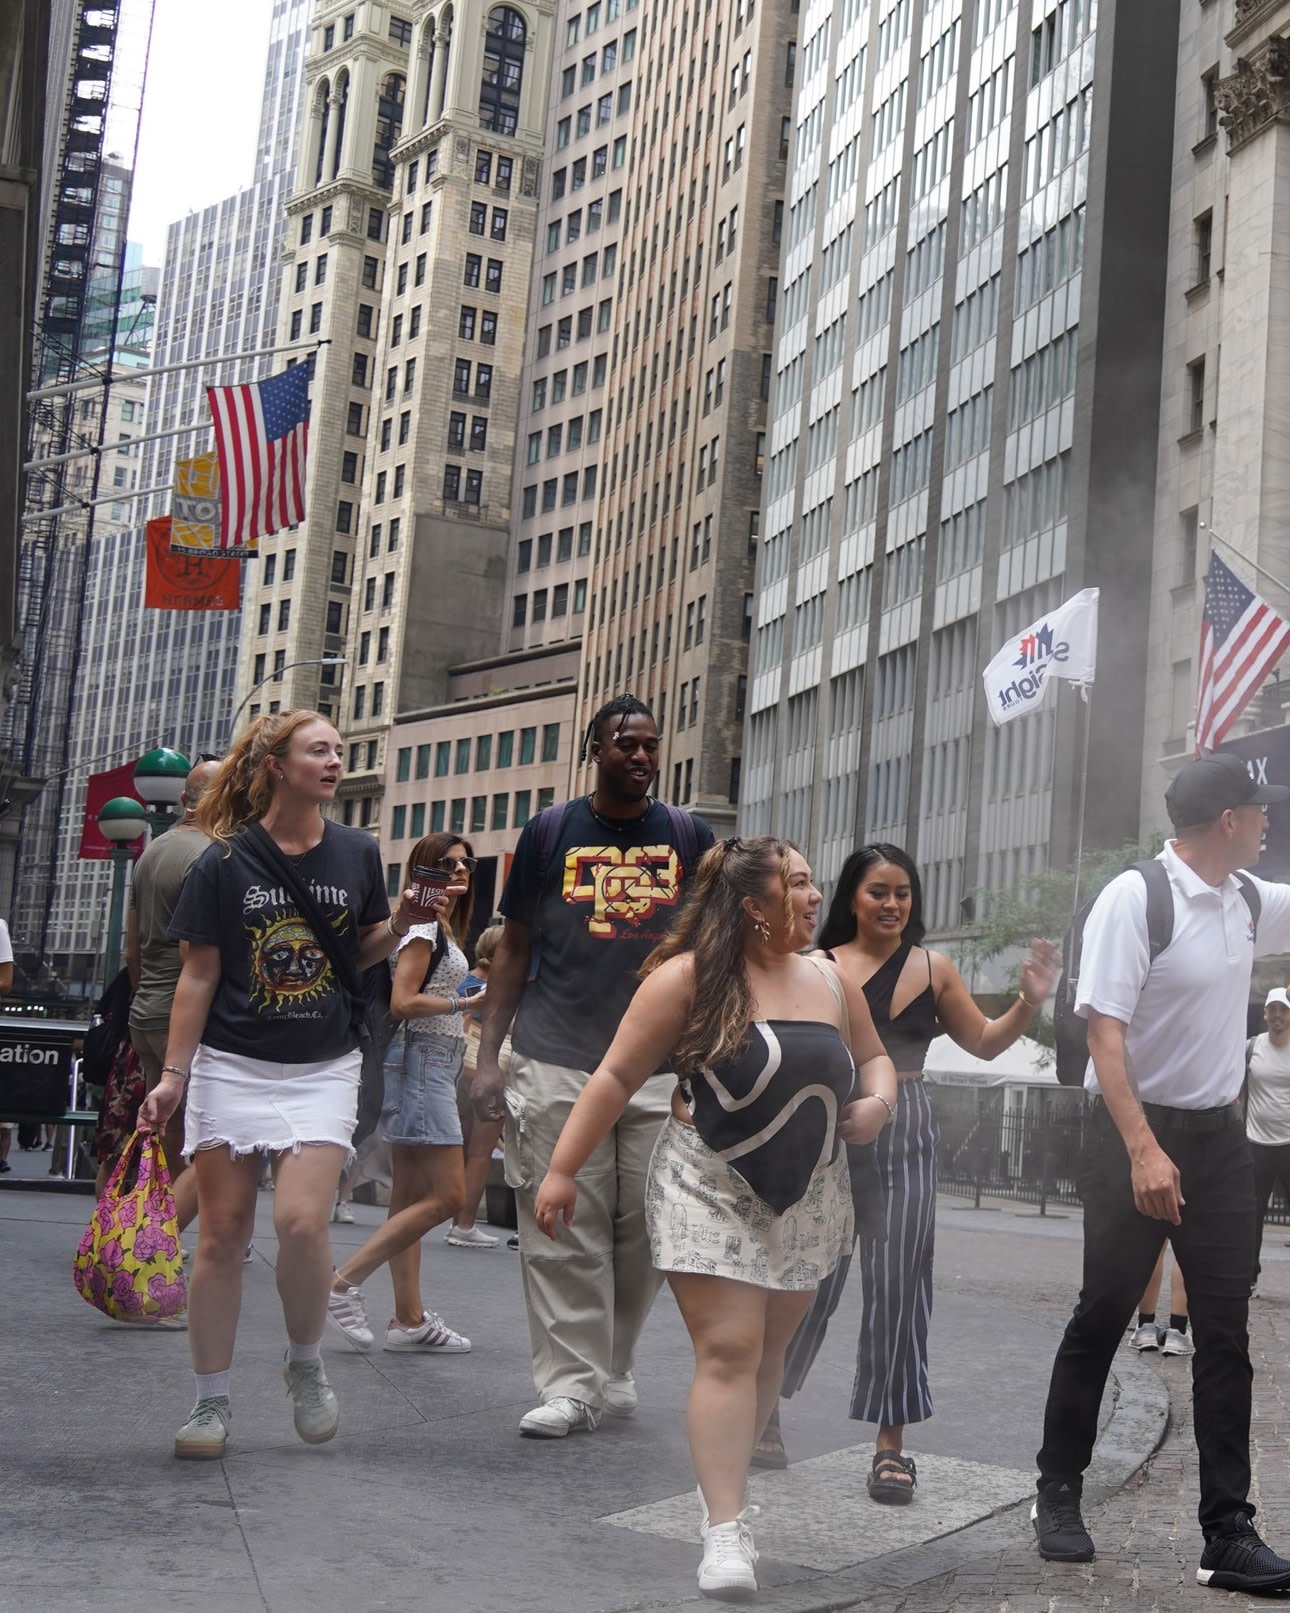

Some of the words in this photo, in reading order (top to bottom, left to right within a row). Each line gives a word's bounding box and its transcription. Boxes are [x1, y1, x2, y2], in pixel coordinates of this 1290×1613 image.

[188, 548, 219, 557] BROAD
[242, 878, 349, 915] Suime
[0, 1044, 59, 1065] ation
